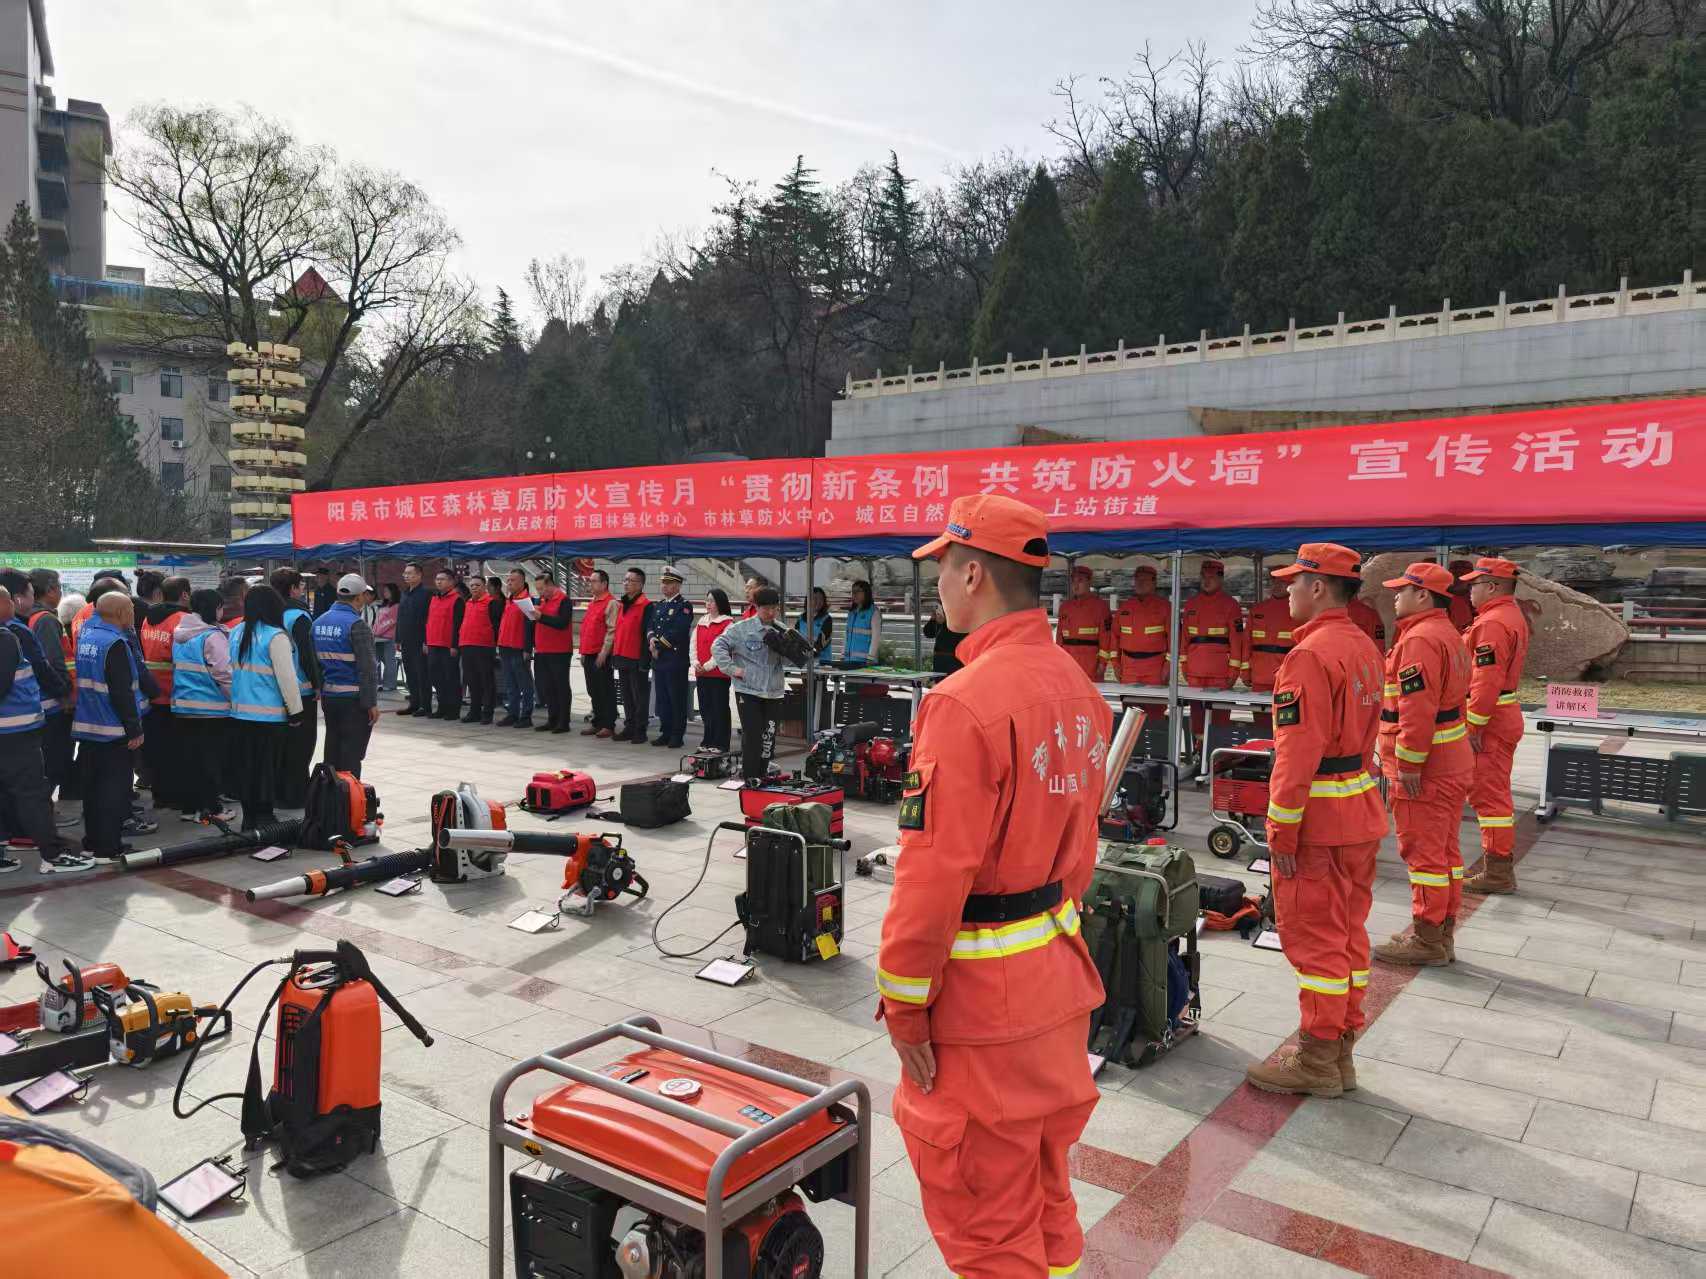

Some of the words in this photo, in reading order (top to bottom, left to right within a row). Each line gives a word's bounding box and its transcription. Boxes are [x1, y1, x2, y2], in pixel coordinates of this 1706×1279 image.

[327, 477, 697, 522] 阳泉市城区森林草原防火宣传月
[720, 464, 949, 504] “贯彻新条例
[978, 444, 1302, 494] 共筑防火墙”
[1347, 422, 1674, 481] 宣传活动
[478, 514, 559, 533] 城区人民政府
[573, 511, 688, 530] 市园林绿化中心
[703, 506, 835, 528] 市林草防火中心
[855, 501, 946, 525] 城区自然
[1043, 495, 1160, 518] 上站街道
